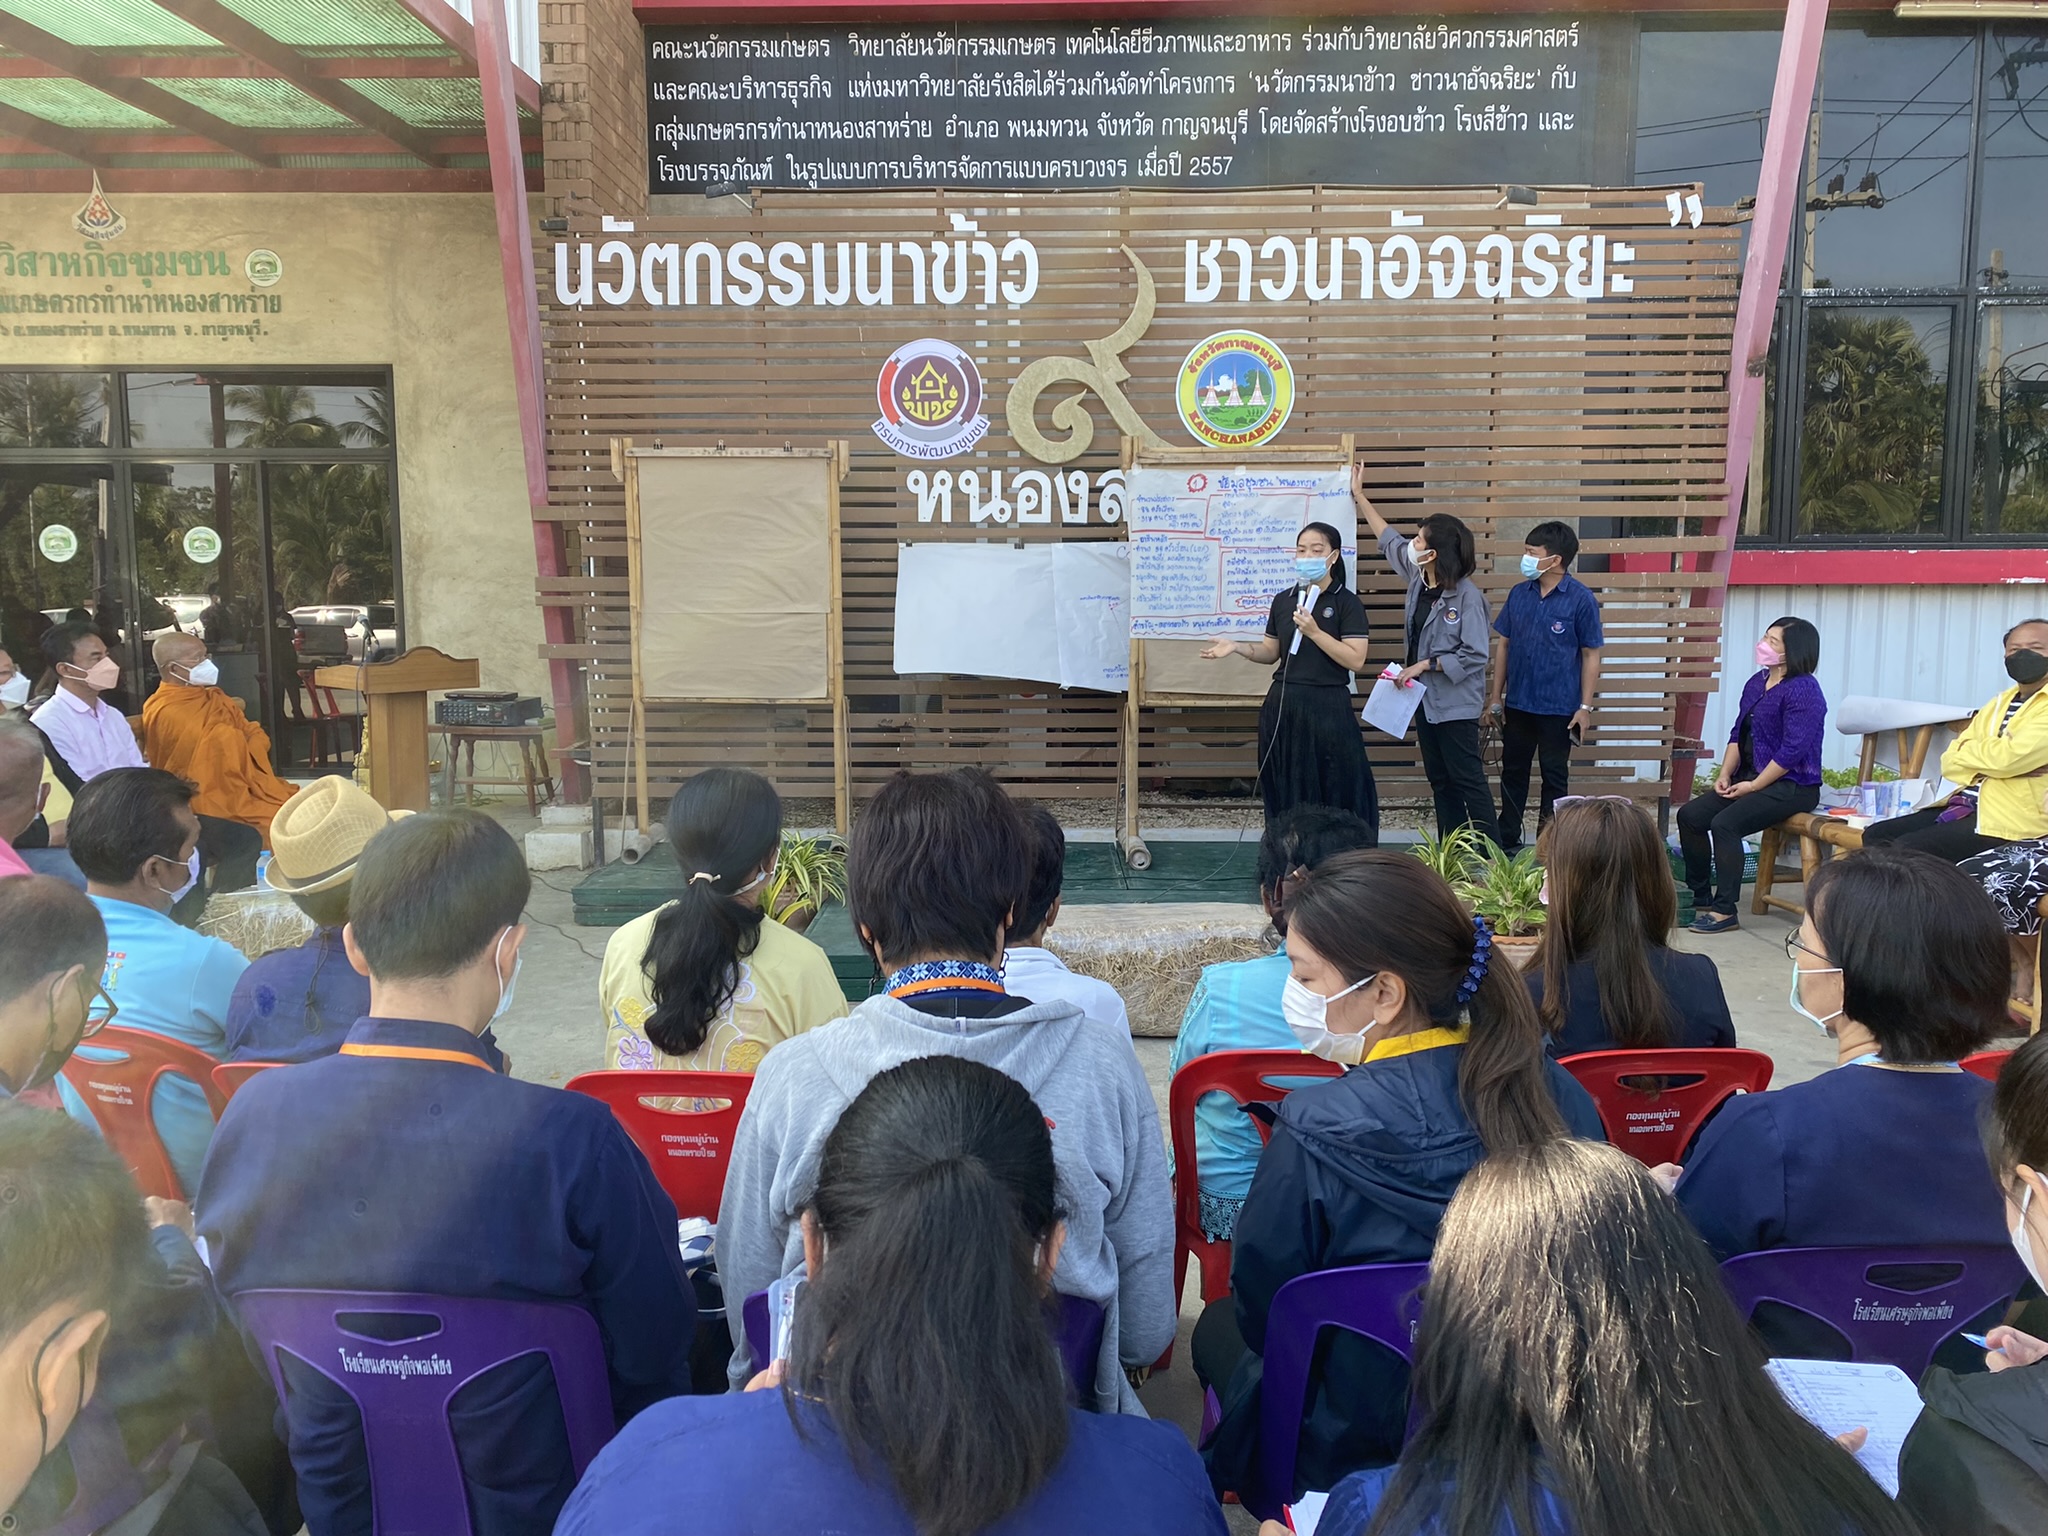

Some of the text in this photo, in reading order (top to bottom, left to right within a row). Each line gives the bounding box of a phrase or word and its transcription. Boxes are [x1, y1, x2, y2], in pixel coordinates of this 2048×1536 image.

[652, 33, 830, 59] คณะนวัตกรรมเกษตร
[848, 31, 1056, 57] วิทยาลัยนวัตกรรมเกษตร
[1301, 21, 1580, 52] ร่วมกับวิทยาลัยวิศวกรรมศาสตร์
[653, 74, 832, 109] และคณะบริหารธุรกิจ
[848, 67, 1235, 99] แห่งมหาวิทยาลัยรังสิตได้ร่วมกันจัดทำโครงการ
[1551, 63, 1577, 90] กับ
[655, 103, 1575, 150] กลุ่มเกษตรกรทำนาหนองสาหร่าย อำเภอ พนมทวน จังหวัด กาญจนบุรี โดยจัดสร้างโรงอบข้าว โรงสีข้าว และ
[785, 153, 1128, 189] ในรูปแบบการบริหารจัดการแบบครบวงจร
[1137, 145, 1182, 177] เมื่อปี
[1189, 156, 1233, 176] 2557
[0, 241, 231, 288] วิสาหกิจชุมชน
[554, 213, 1040, 307] นวัตกรรมนาข้าว
[873, 417, 989, 458] กรมการพัฒนาชุมชน
[1188, 407, 1283, 444] KANCHANABURI
[1852, 1298, 1954, 1325] โรงเรียนเศรษฐกิจพอเพียง
[338, 1347, 452, 1380] โรงเรียนเศรษฐกิจพอเพียง
